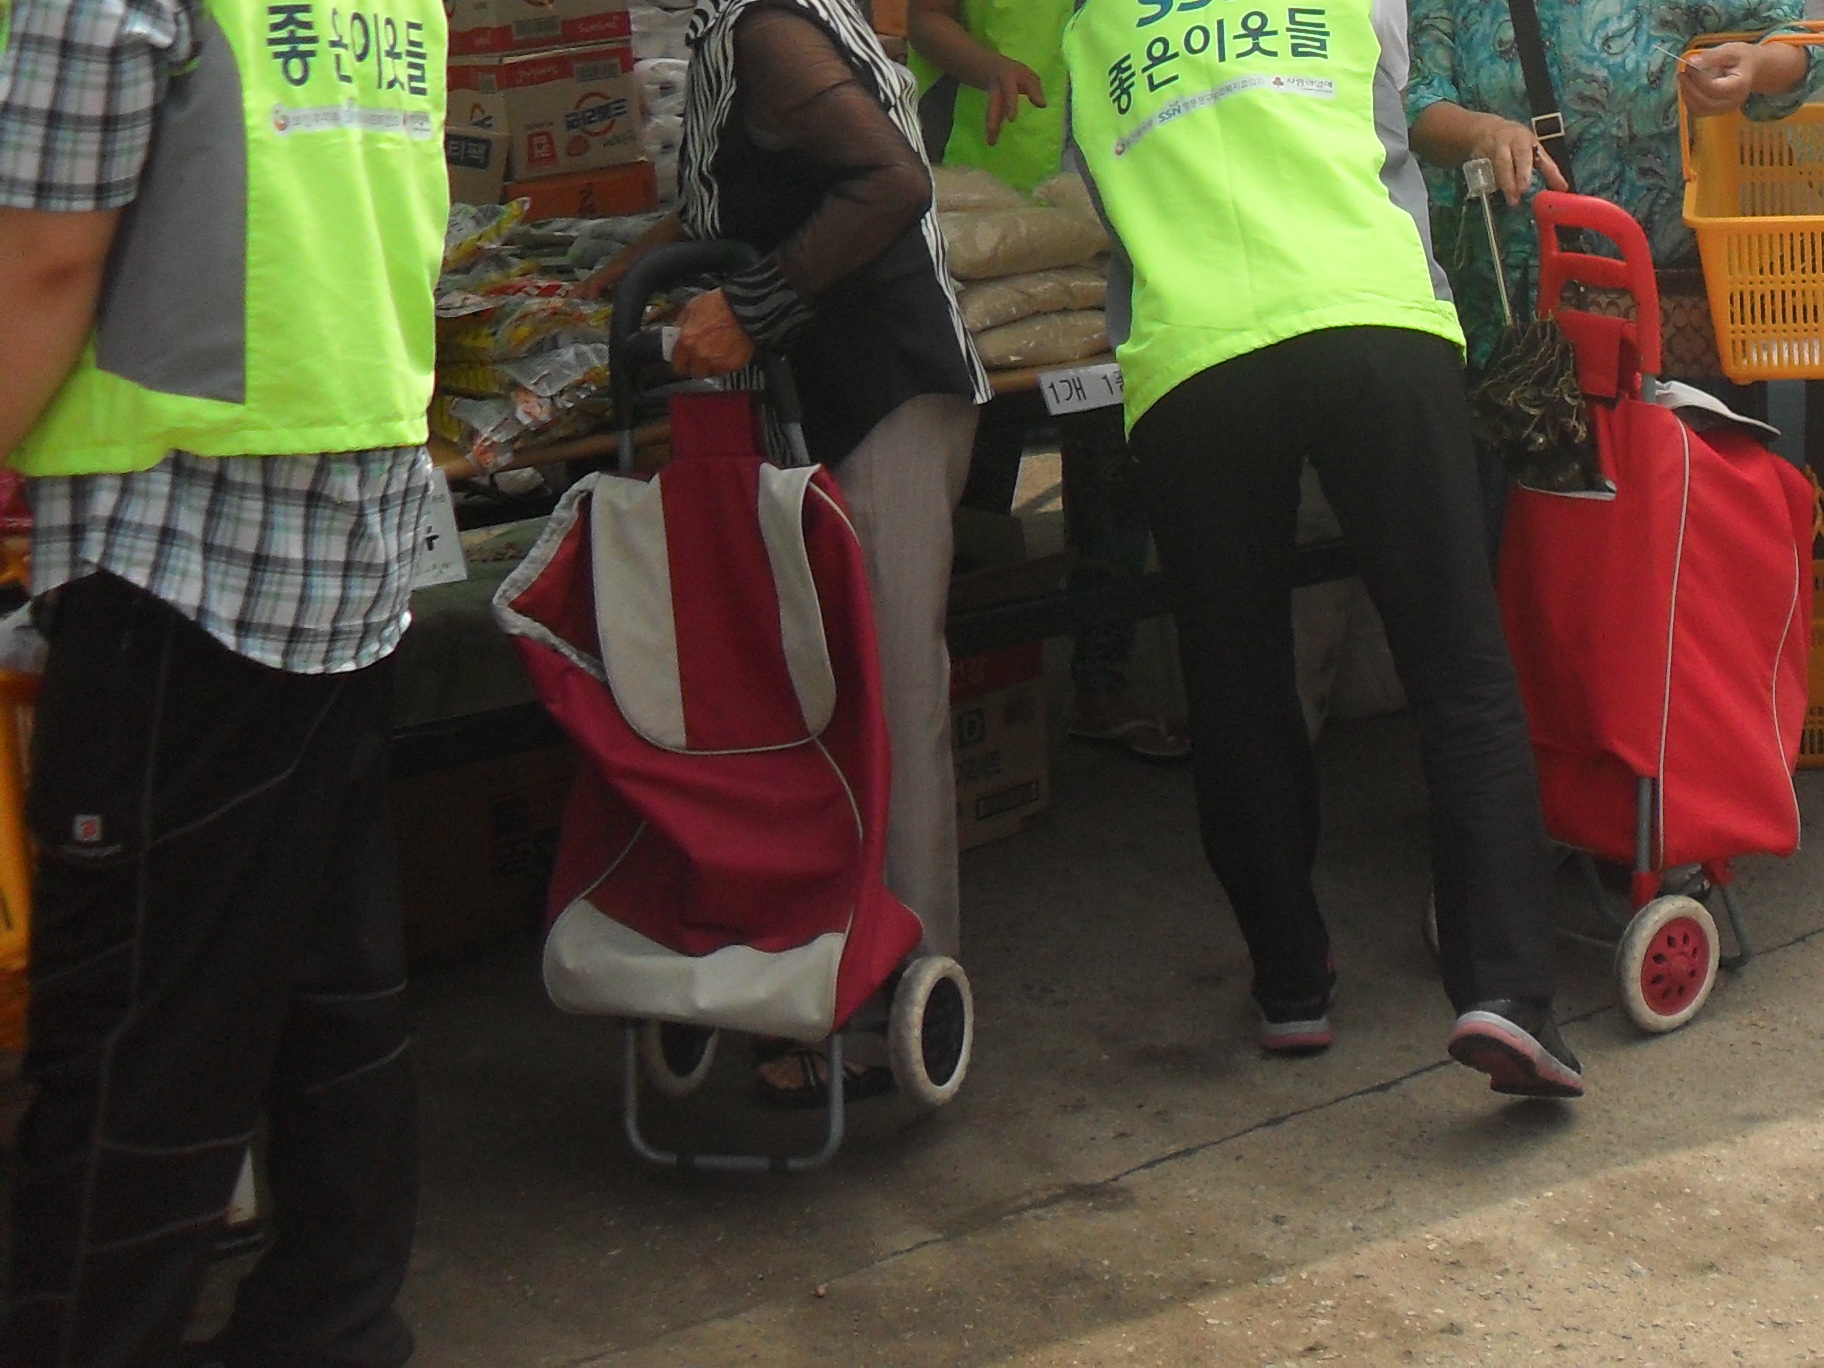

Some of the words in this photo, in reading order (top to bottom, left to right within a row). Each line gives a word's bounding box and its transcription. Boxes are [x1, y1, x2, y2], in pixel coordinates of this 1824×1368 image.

[262, 4, 428, 97] 좋은이웃들
[1108, 7, 1331, 116] 좋은이웃들
[1157, 104, 1182, 123] SSN
